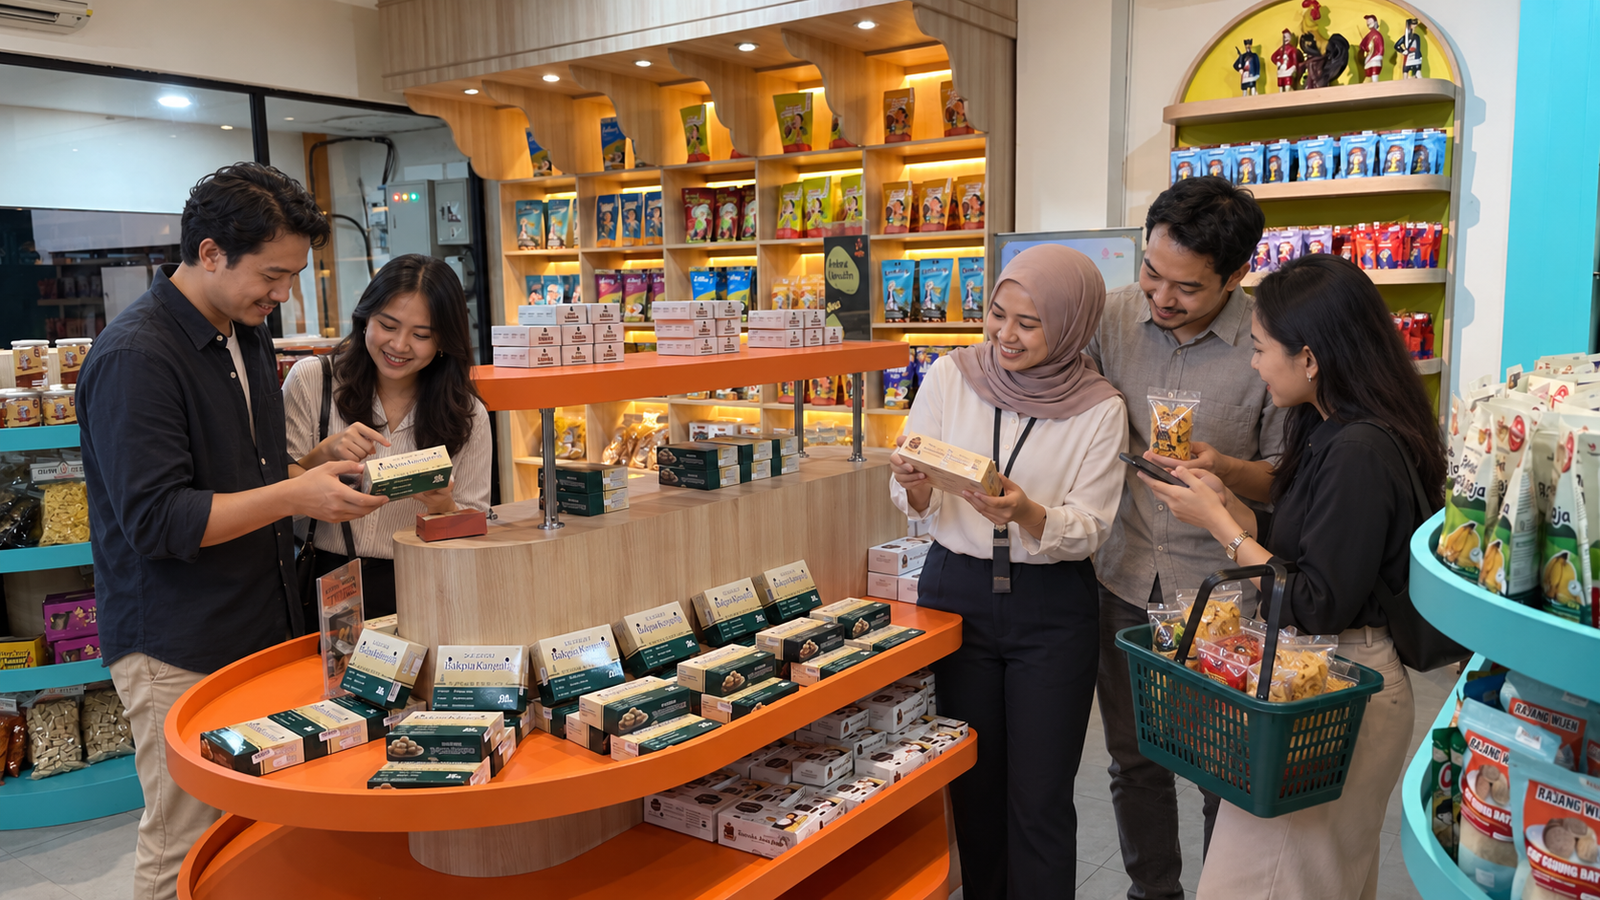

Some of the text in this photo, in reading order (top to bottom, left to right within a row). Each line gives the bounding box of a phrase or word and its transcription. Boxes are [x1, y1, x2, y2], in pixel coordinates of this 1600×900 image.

[1514, 702, 1579, 732] RAJANG WIJEN
[1537, 786, 1582, 812] RAJANG
[1584, 802, 1600, 819] WI
